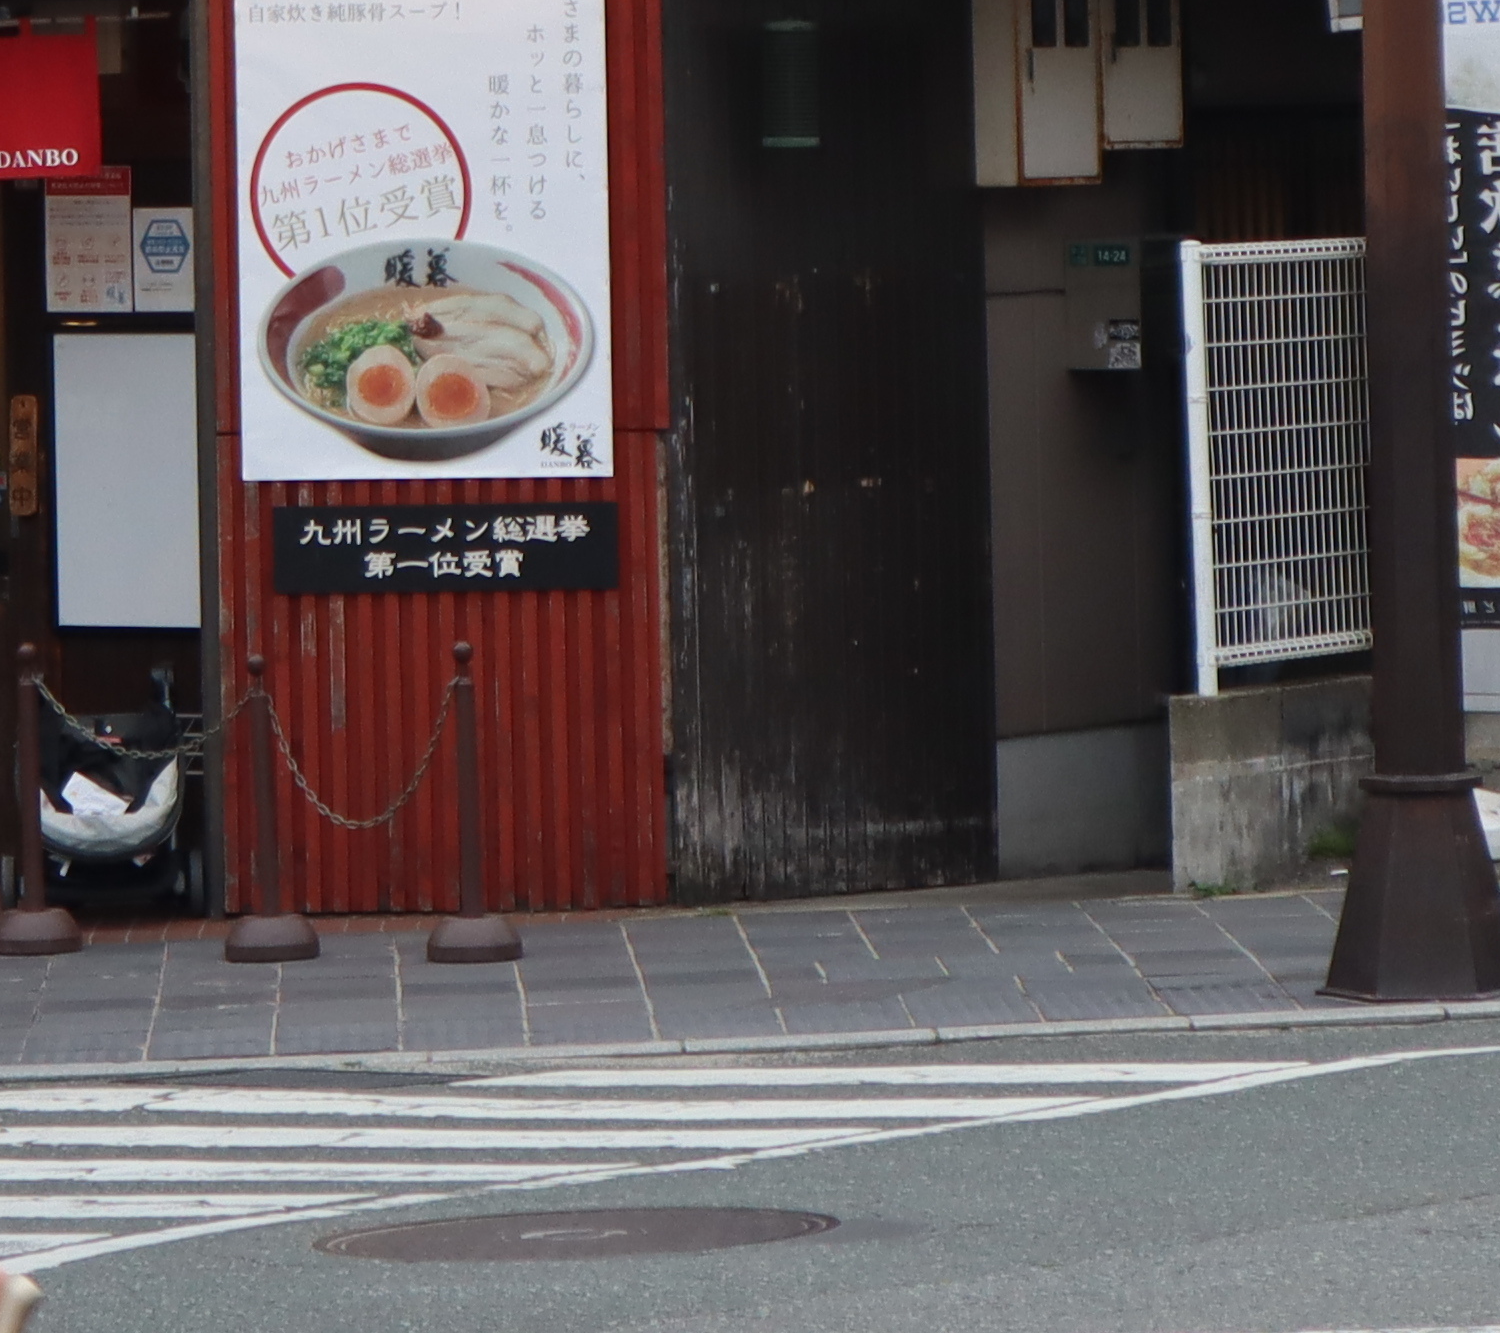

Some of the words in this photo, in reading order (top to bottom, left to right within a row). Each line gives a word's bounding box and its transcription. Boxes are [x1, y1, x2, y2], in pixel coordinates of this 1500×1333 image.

[285, 122, 412, 169] おかげさまで
[525, 24, 548, 221] ホッと一息つける
[258, 140, 454, 208] 九州ラーメン総選挙
[271, 174, 462, 253] 第1位受賞
[299, 515, 591, 546] 九州ラーメン総選挙
[363, 550, 524, 579] 第一位受賞
